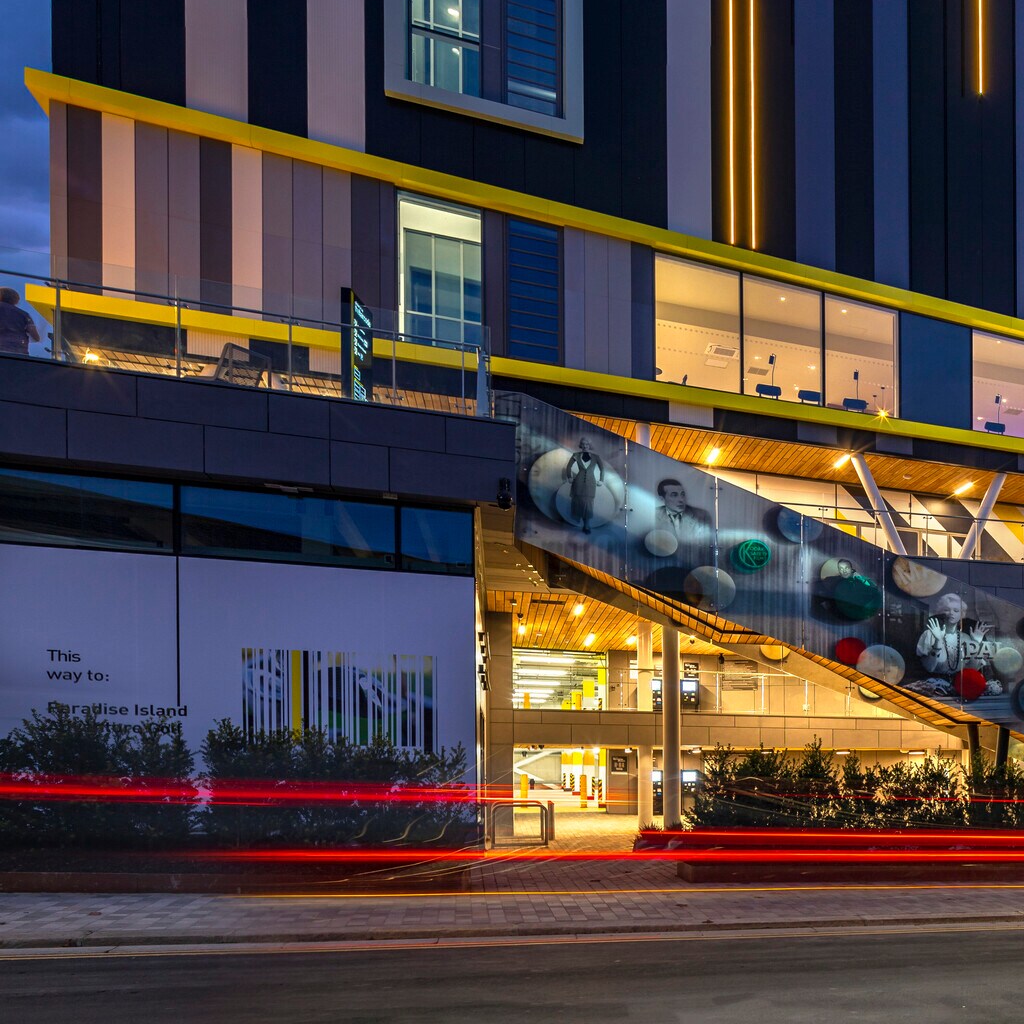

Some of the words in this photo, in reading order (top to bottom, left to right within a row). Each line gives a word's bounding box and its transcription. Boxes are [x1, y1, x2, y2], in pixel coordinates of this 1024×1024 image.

[47, 649, 81, 663] This
[46, 670, 82, 683] way
[87, 670, 110, 682] to:
[134, 704, 188, 717] Island
